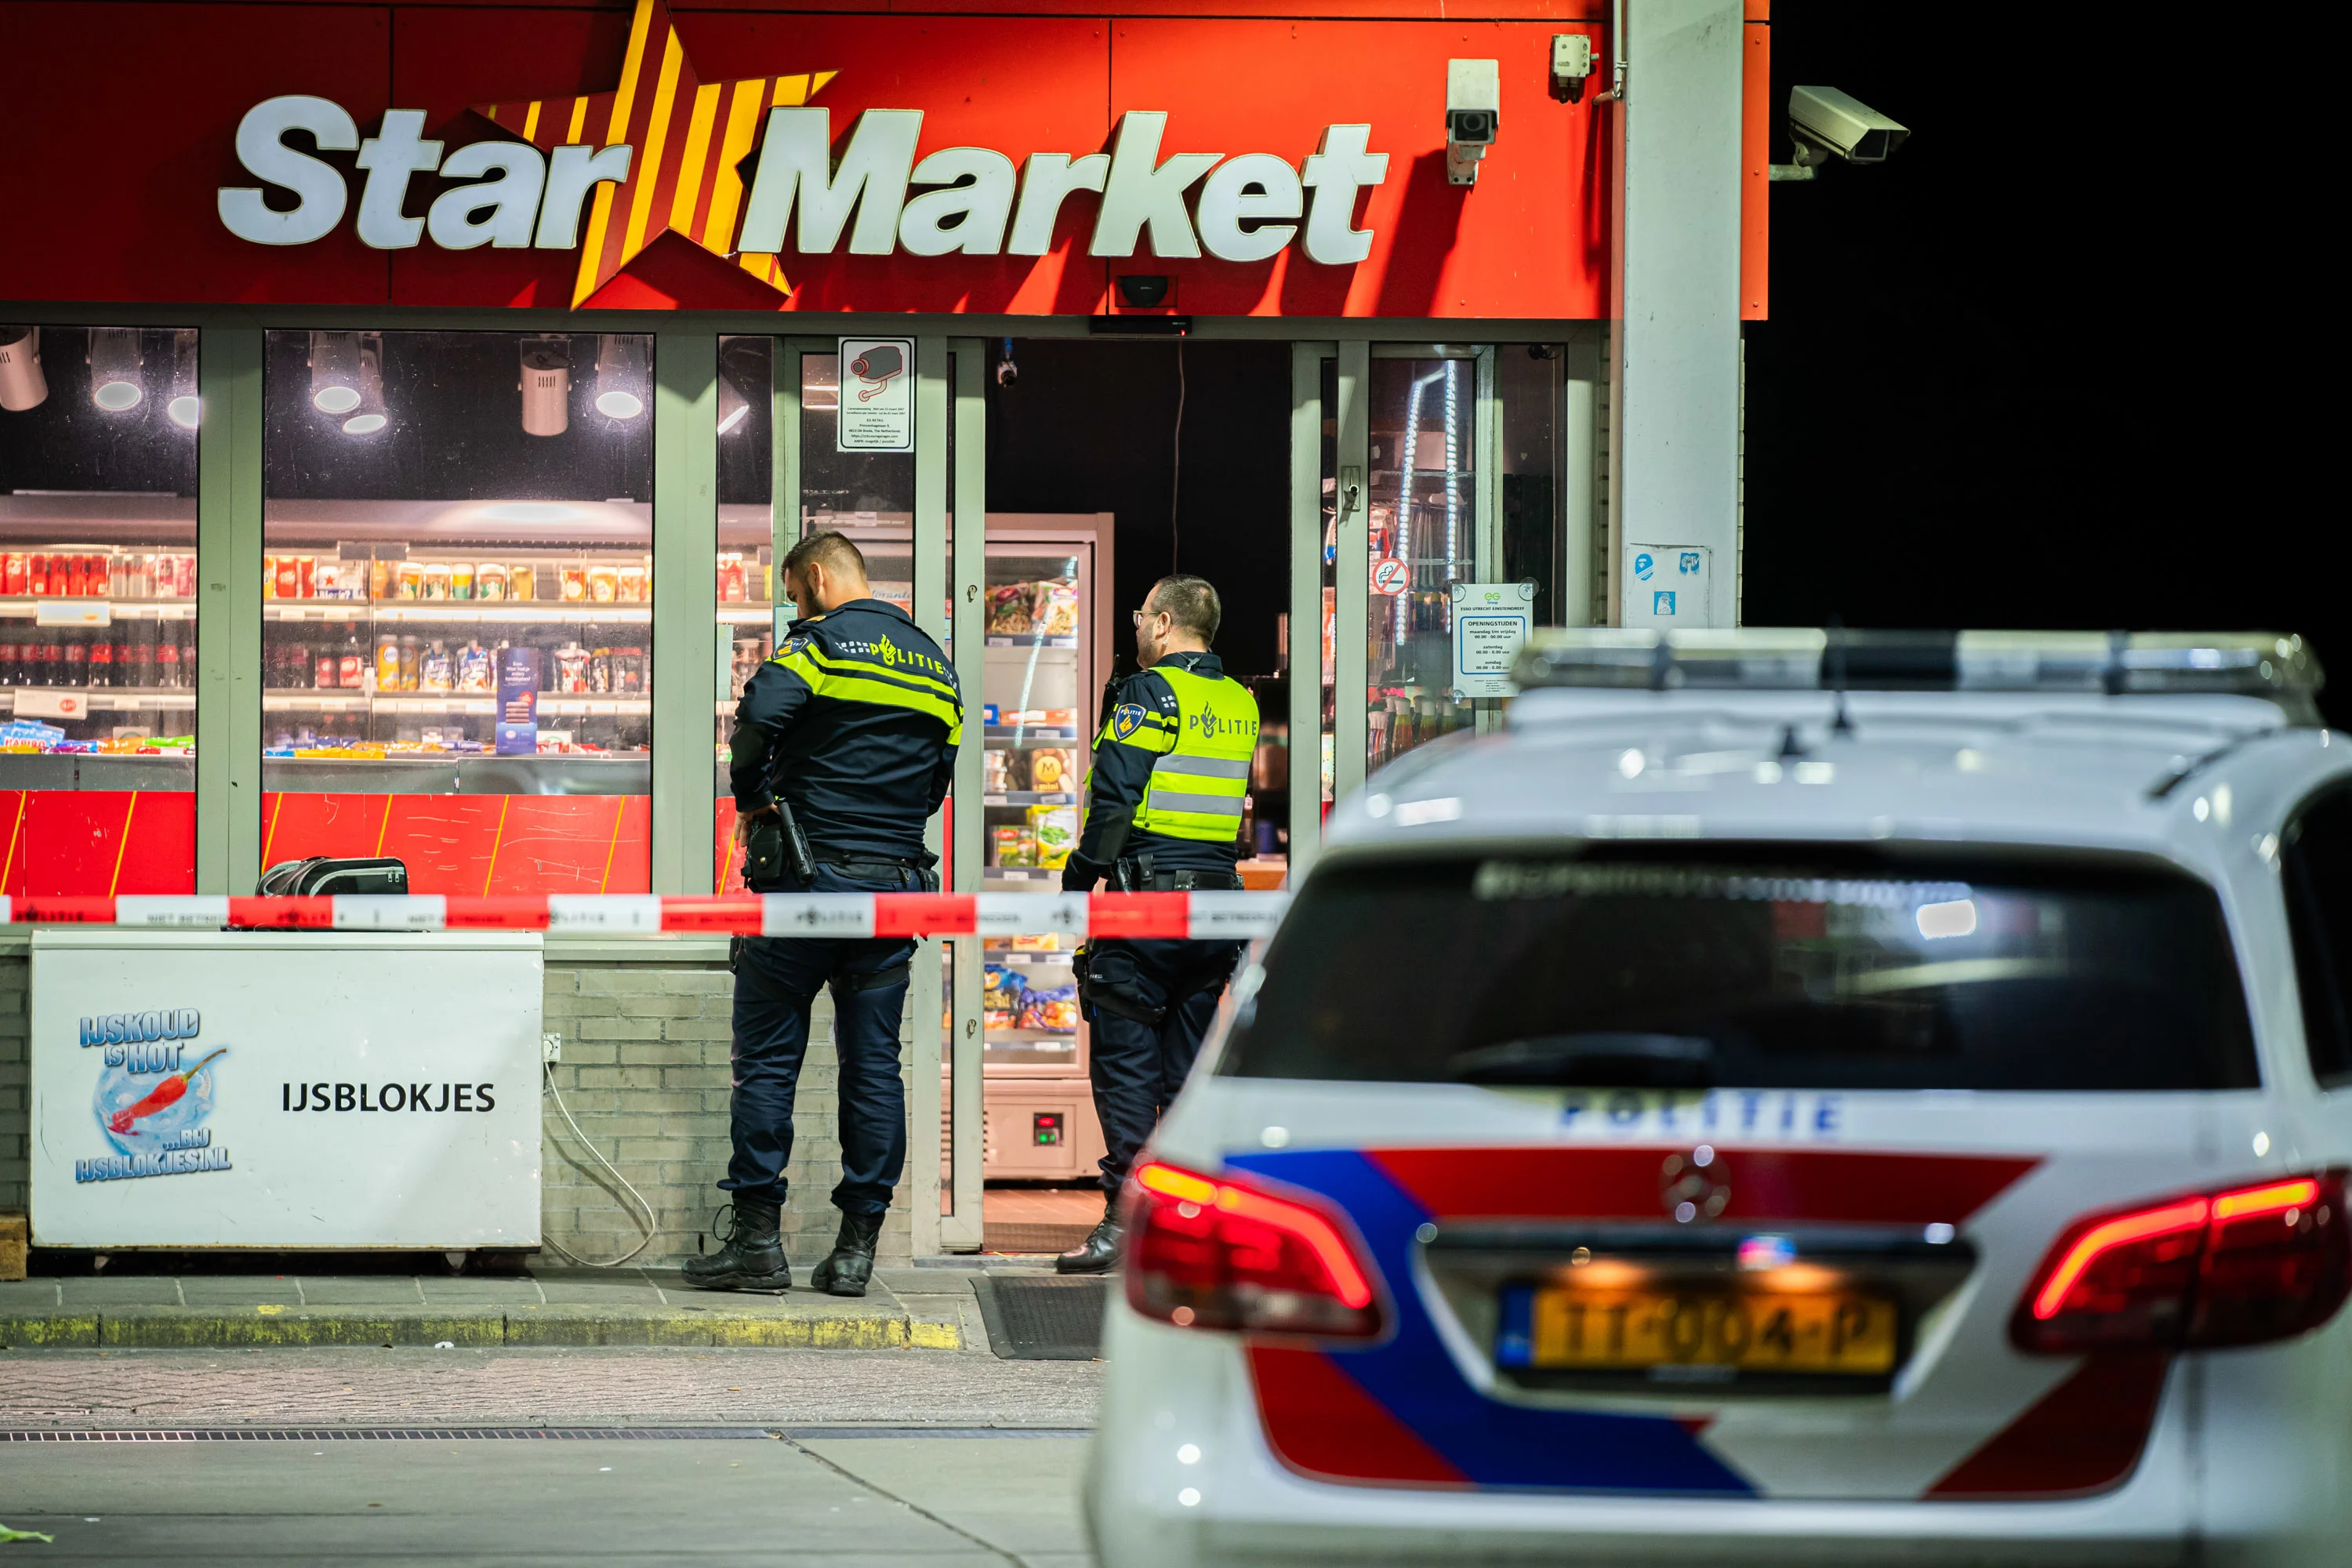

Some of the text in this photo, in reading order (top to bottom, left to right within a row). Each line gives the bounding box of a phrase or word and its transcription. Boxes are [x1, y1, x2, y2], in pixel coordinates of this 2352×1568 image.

[217, 94, 1389, 266] Star Market
[869, 634, 945, 674] POLITIE
[1120, 706, 1142, 716] POLITIE
[1189, 702, 1258, 739] POLITIE
[1042, 763, 1054, 773] M
[80, 1007, 200, 1047] IJSKOUD
[104, 1040, 184, 1074] IS HOT
[282, 1082, 495, 1112] IJSBLOKJES
[1560, 1091, 1844, 1134] POLITIE
